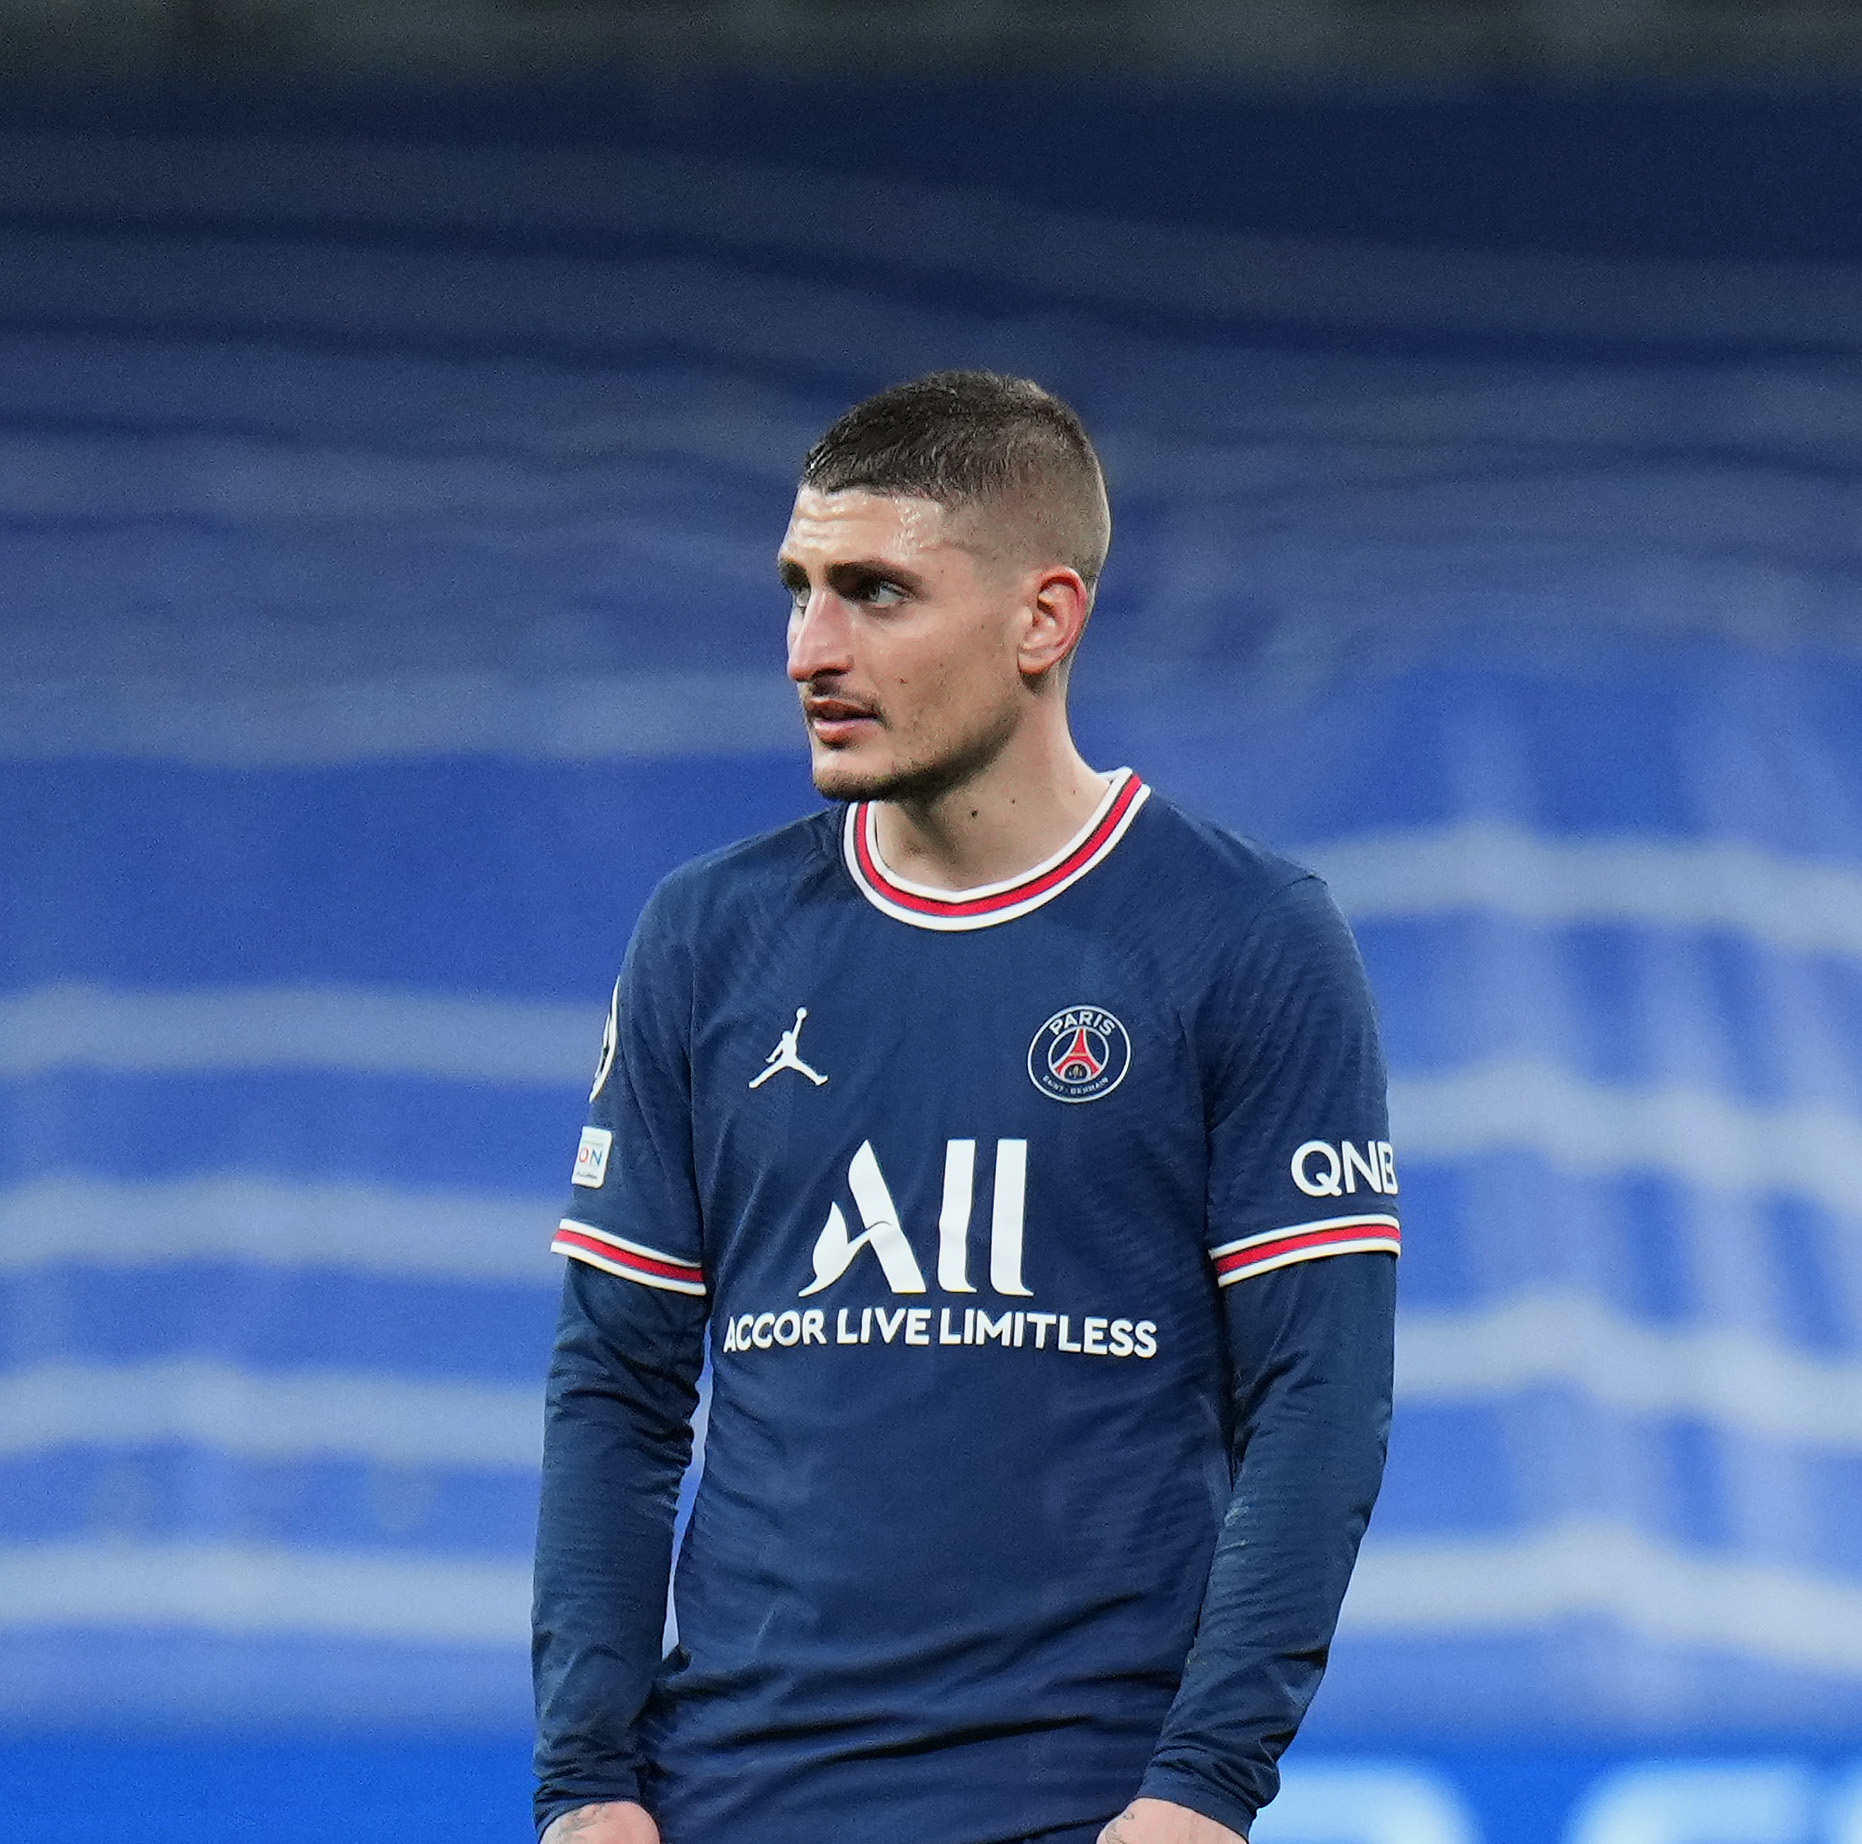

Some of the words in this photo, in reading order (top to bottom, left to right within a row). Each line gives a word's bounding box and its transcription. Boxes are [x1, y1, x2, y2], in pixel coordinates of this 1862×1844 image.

[1049, 1010, 1116, 1036] PARIS
[1290, 1140, 1399, 1197] QNB
[723, 1309, 827, 1353] ACCOR
[836, 1307, 932, 1346] LIVE
[938, 1308, 1158, 1360] LIMITLESS
